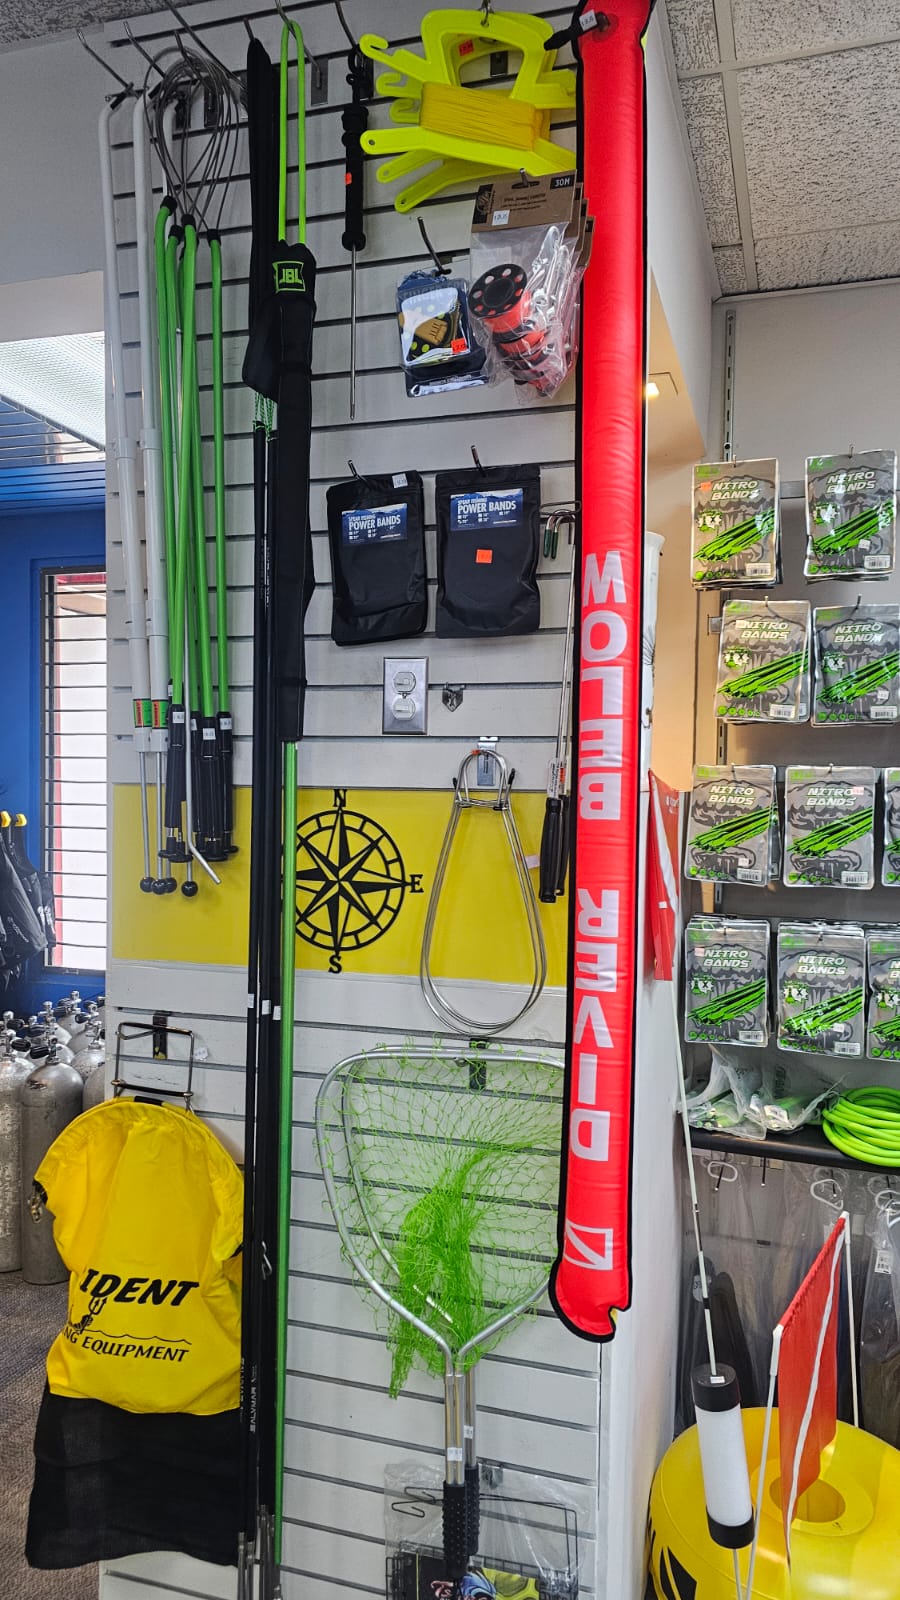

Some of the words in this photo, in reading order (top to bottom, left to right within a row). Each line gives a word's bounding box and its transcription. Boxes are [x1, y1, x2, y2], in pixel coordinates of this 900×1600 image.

[279, 268, 303, 285] JBL
[827, 471, 875, 484] NITRO
[713, 480, 758, 491] NITRO
[711, 490, 761, 501] BANDS
[457, 502, 487, 515] POWER
[488, 500, 517, 512] BANDS
[348, 519, 376, 531] POWER
[376, 514, 401, 527] BANDS
[743, 621, 789, 631] NITRO
[835, 622, 882, 634] NITRO
[740, 630, 791, 640] BANDS
[710, 785, 755, 795] NITRO
[807, 787, 854, 797] NITRO
[333, 789, 348, 808] N
[708, 795, 756, 805] BANDS
[806, 797, 857, 806] BANDS
[409, 874, 424, 893] E
[703, 949, 749, 958] NITRO
[328, 955, 343, 974] S
[703, 959, 750, 968] BANDS
[798, 955, 845, 965] NITRO
[797, 965, 847, 975] BANDS
[82, 1336, 190, 1362] EQUIPMENT
